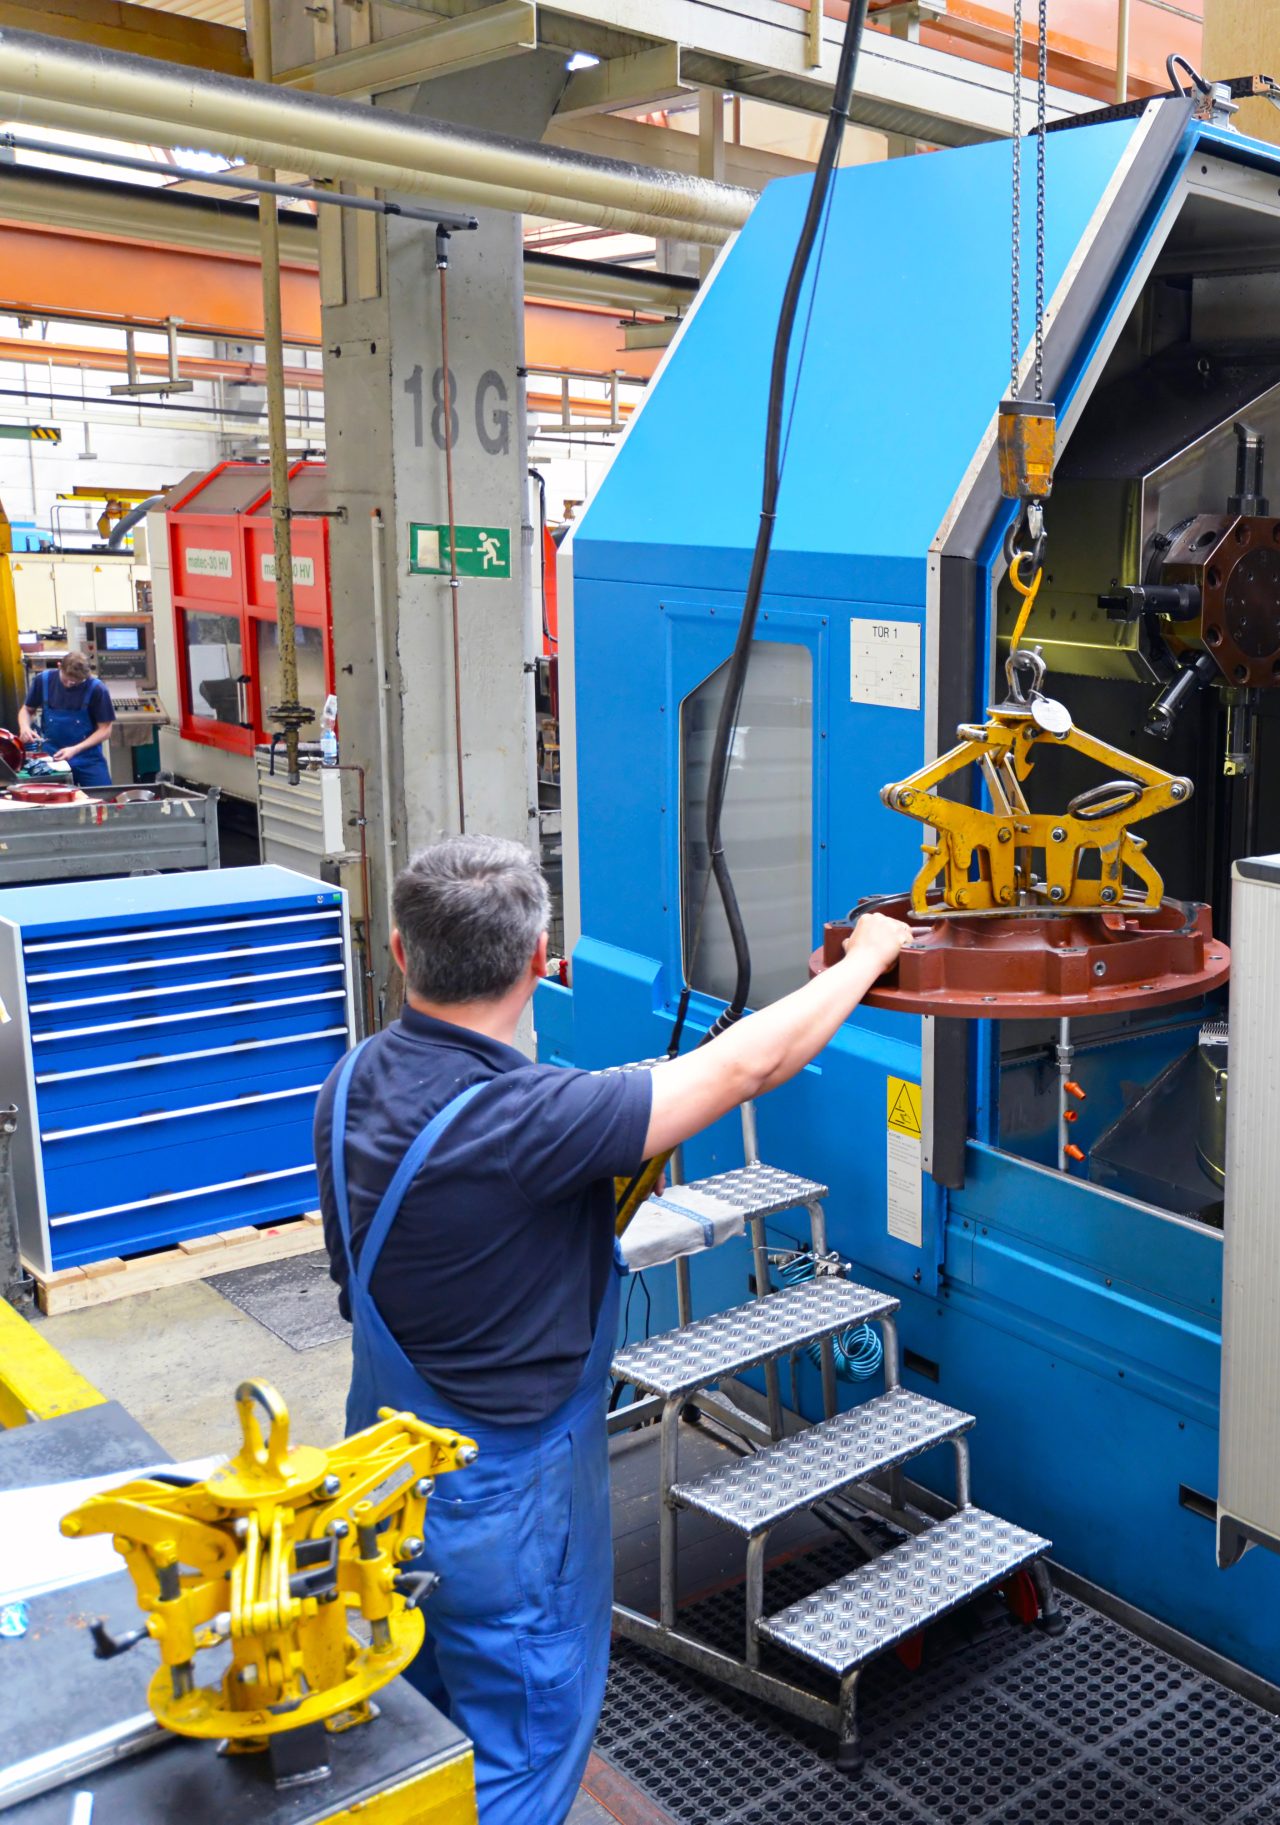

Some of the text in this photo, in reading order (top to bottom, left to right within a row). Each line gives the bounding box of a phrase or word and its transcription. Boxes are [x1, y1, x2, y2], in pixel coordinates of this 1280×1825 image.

[404, 364, 510, 456] 18 G
[218, 556, 229, 571] HV
[300, 563, 311, 579] HV
[892, 627, 898, 639] 1
